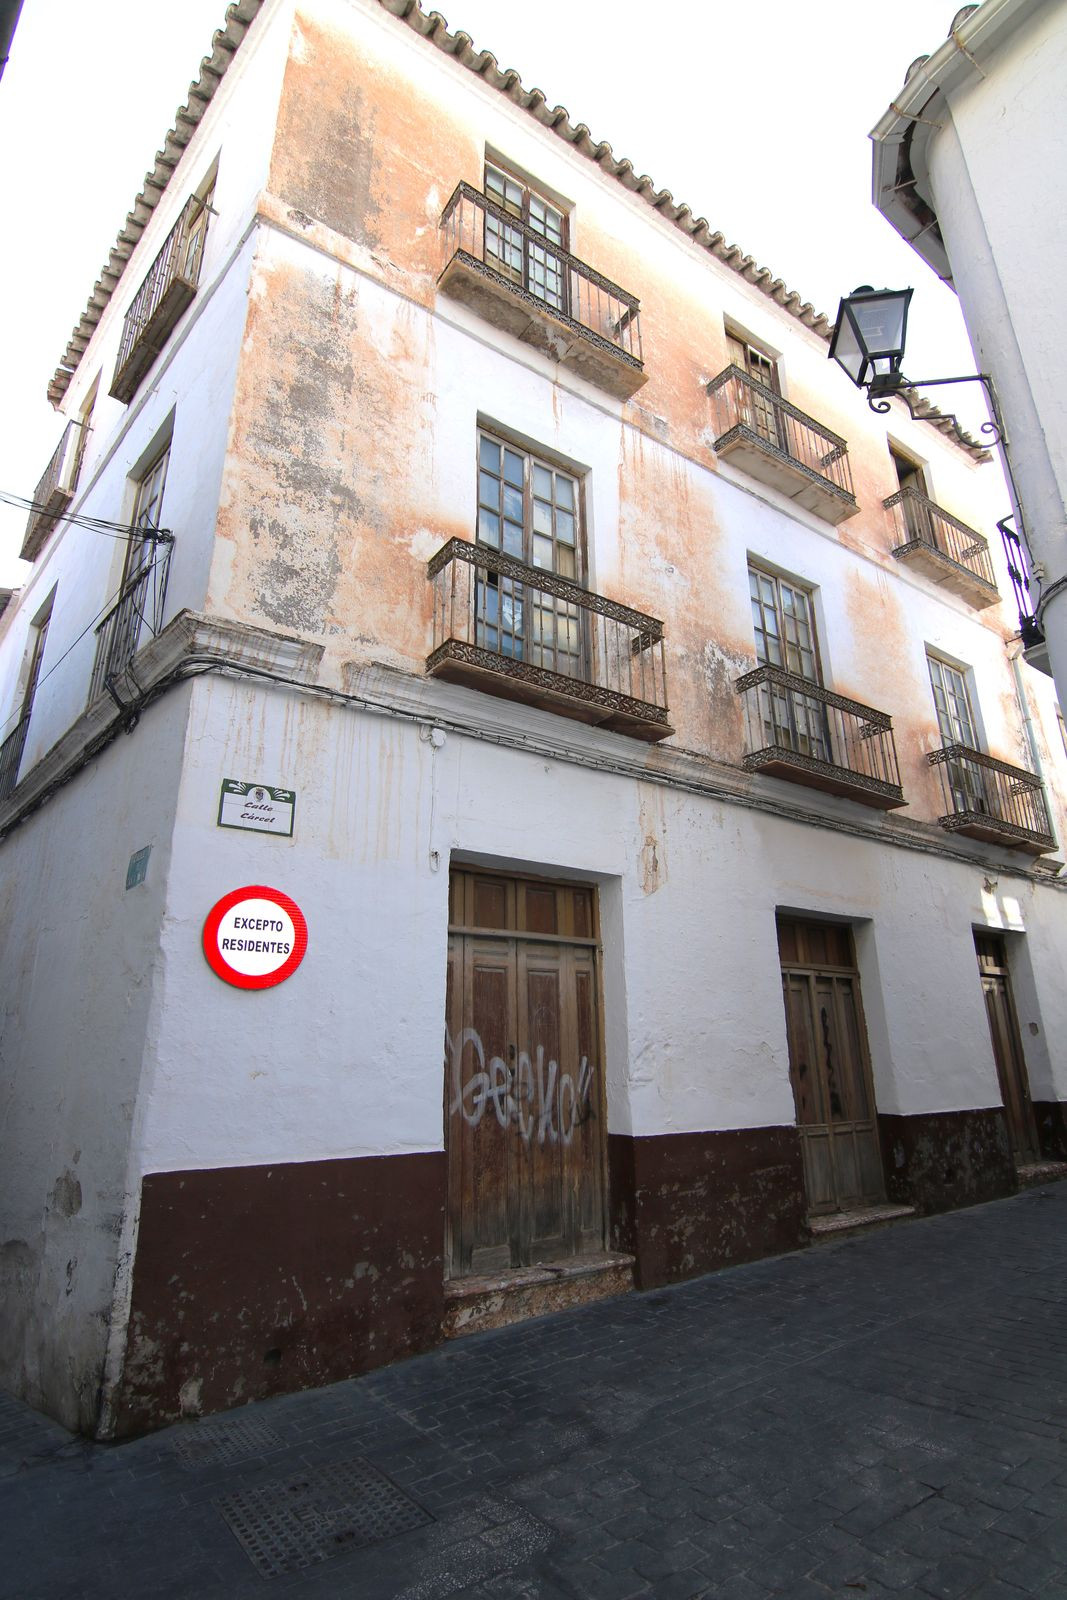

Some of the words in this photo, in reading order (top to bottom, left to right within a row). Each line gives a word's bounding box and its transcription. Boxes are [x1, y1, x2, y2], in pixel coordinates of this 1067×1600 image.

[244, 802, 273, 812] Calle
[240, 812, 276, 823] Cárcel
[233, 917, 284, 932] EXCEPTO
[222, 938, 290, 954] RESIDENTES
